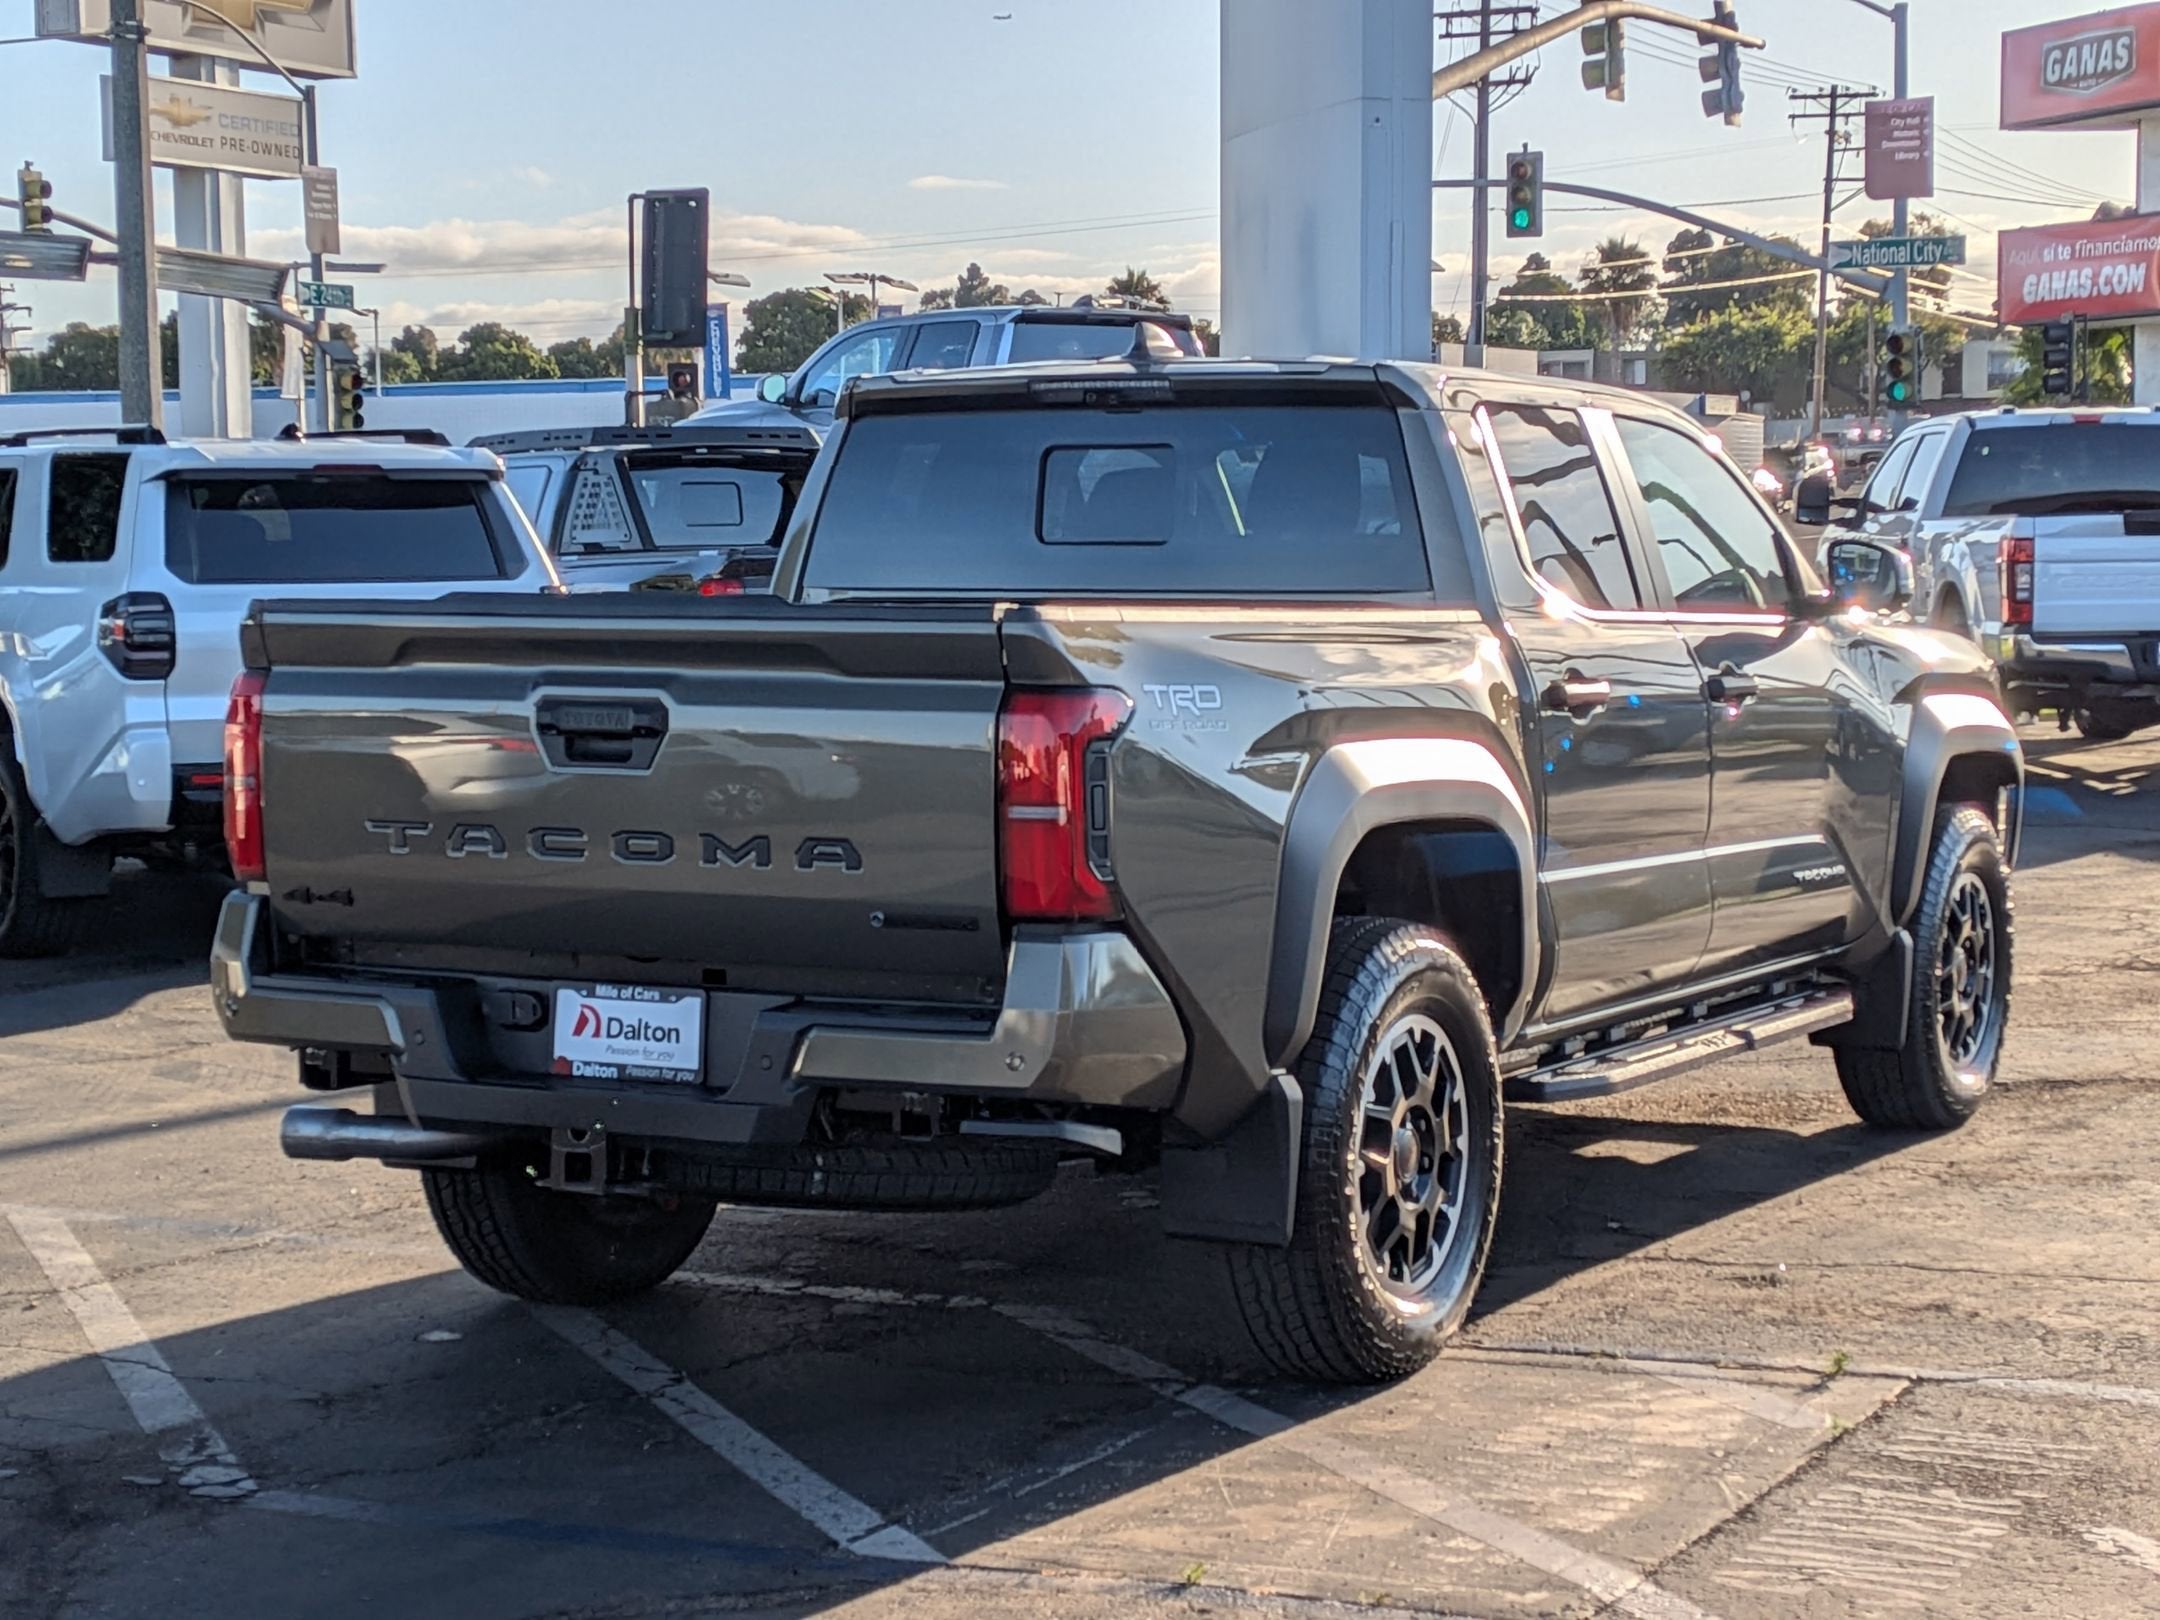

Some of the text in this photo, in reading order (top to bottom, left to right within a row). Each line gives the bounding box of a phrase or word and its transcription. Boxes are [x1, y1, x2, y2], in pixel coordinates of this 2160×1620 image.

[2046, 36, 2131, 83] GANAS
[218, 113, 300, 137] CERTIFIED
[151, 130, 215, 148] CHEVROLET
[220, 136, 300, 159] PRE-OWNED
[1852, 242, 1910, 266] National
[1913, 240, 1943, 266] City
[2057, 245, 2071, 261] te
[2022, 262, 2147, 304] GANAS.COM
[1143, 684, 1221, 716] TRD
[365, 819, 864, 874] TACOMA
[595, 985, 660, 1001] Mile of Cars
[606, 1016, 681, 1044] Dalton
[605, 1045, 675, 1062] Passion for you
[572, 1061, 618, 1079] Dalton
[625, 1065, 660, 1079] Passion
[676, 1070, 695, 1083] you
